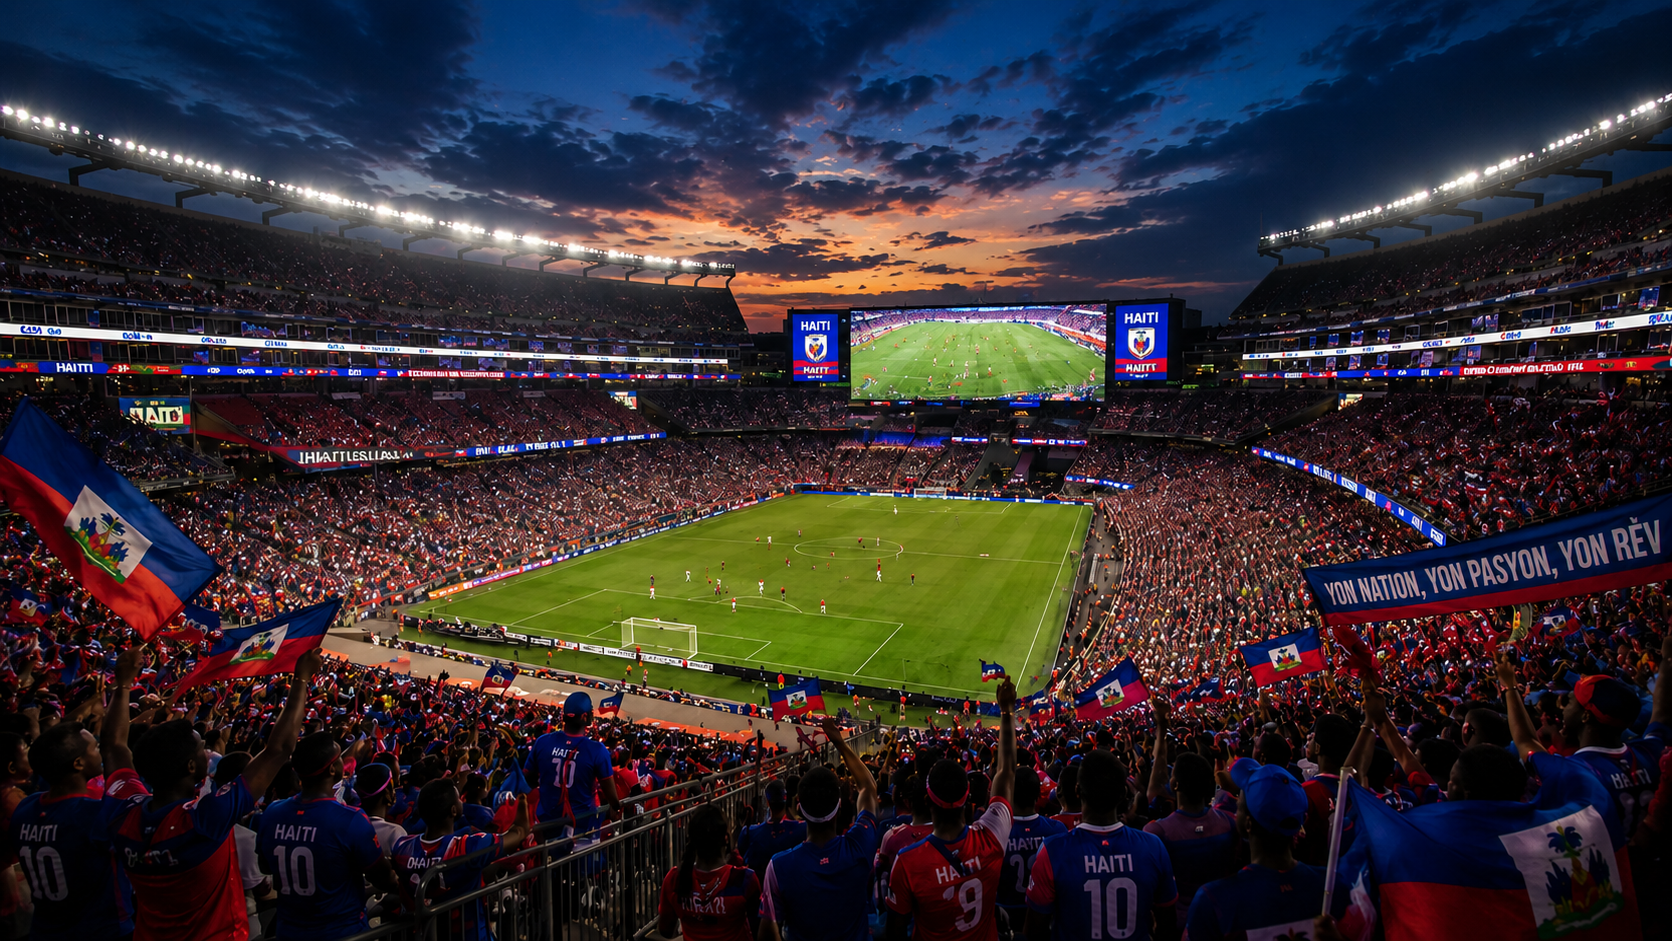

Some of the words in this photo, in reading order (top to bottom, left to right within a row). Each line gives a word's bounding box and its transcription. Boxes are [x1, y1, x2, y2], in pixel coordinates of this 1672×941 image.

[800, 320, 831, 331] HAITI
[1124, 312, 1159, 324] HAITI
[1324, 579, 1359, 606] YON
[1357, 570, 1427, 603] NATION,
[1424, 562, 1468, 594] YON
[1466, 545, 1559, 588] PASYON,
[1558, 532, 1610, 572] YON
[19, 823, 58, 842] HAITI
[274, 823, 318, 843] HAITI
[19, 845, 69, 902] 10
[273, 844, 317, 897] 10
[935, 855, 982, 885] HAITI
[1084, 853, 1134, 874] HAITI
[1083, 876, 1138, 940] 10
